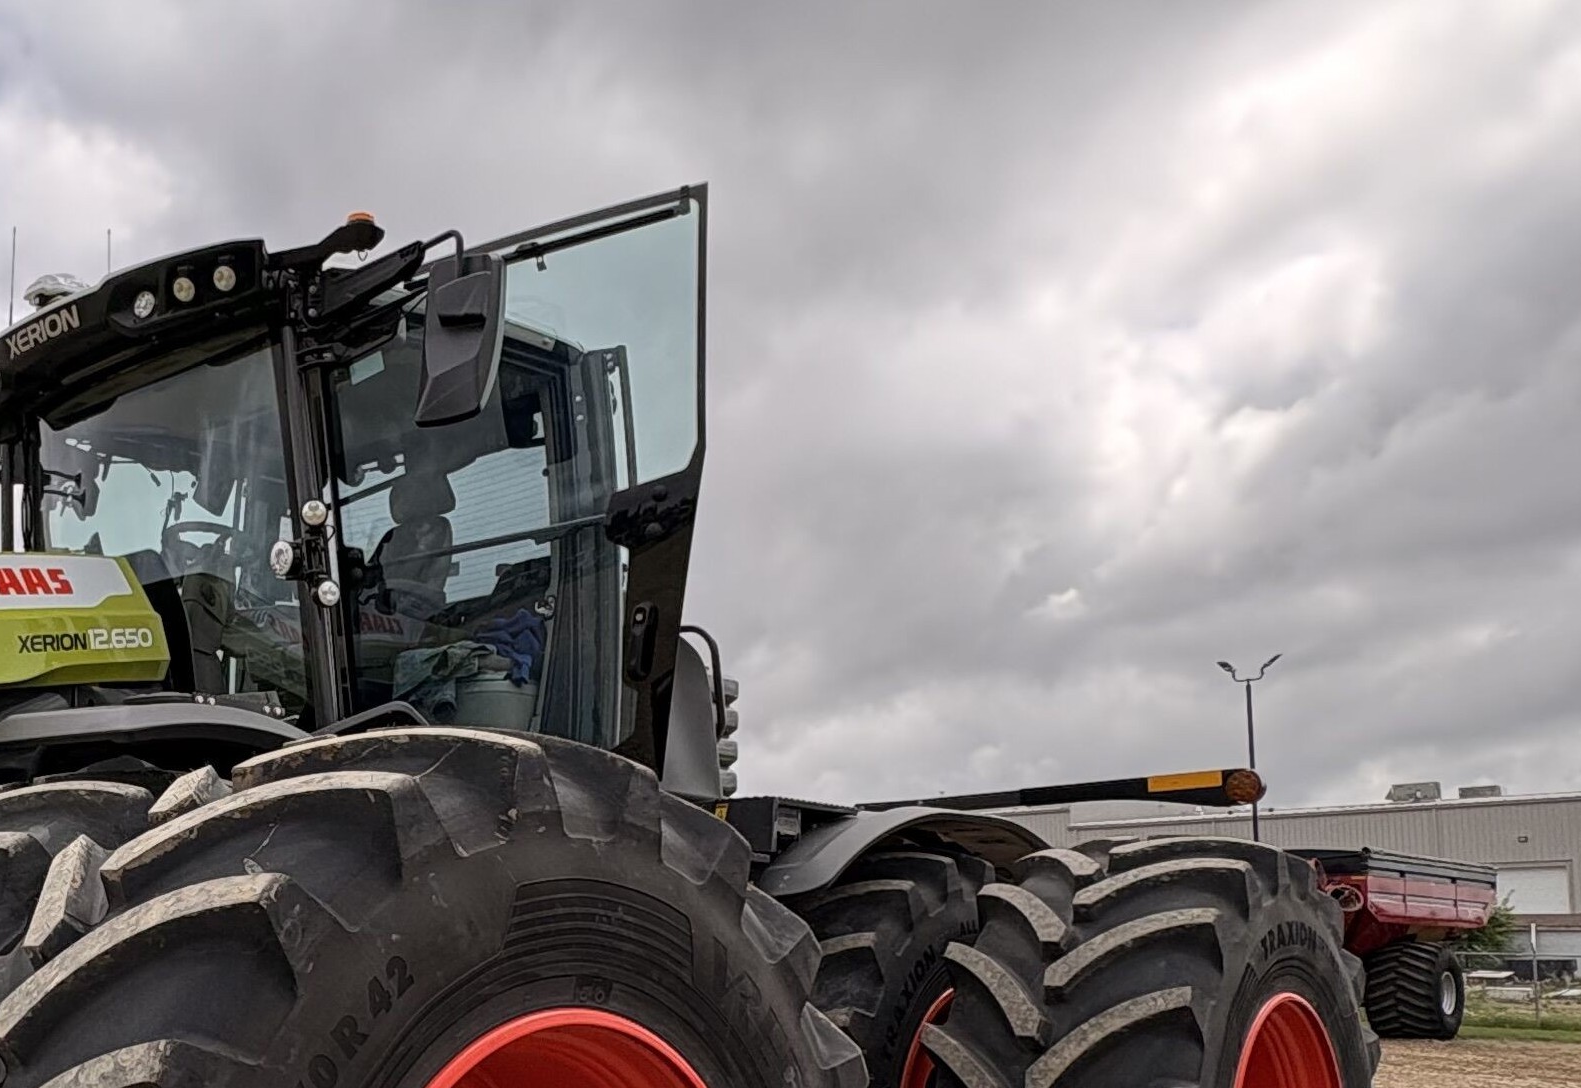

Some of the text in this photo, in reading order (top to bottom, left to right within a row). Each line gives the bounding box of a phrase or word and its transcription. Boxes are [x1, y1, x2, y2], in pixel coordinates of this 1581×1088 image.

[5, 304, 80, 360] XERION
[18, 627, 153, 654] XERION 12.650
